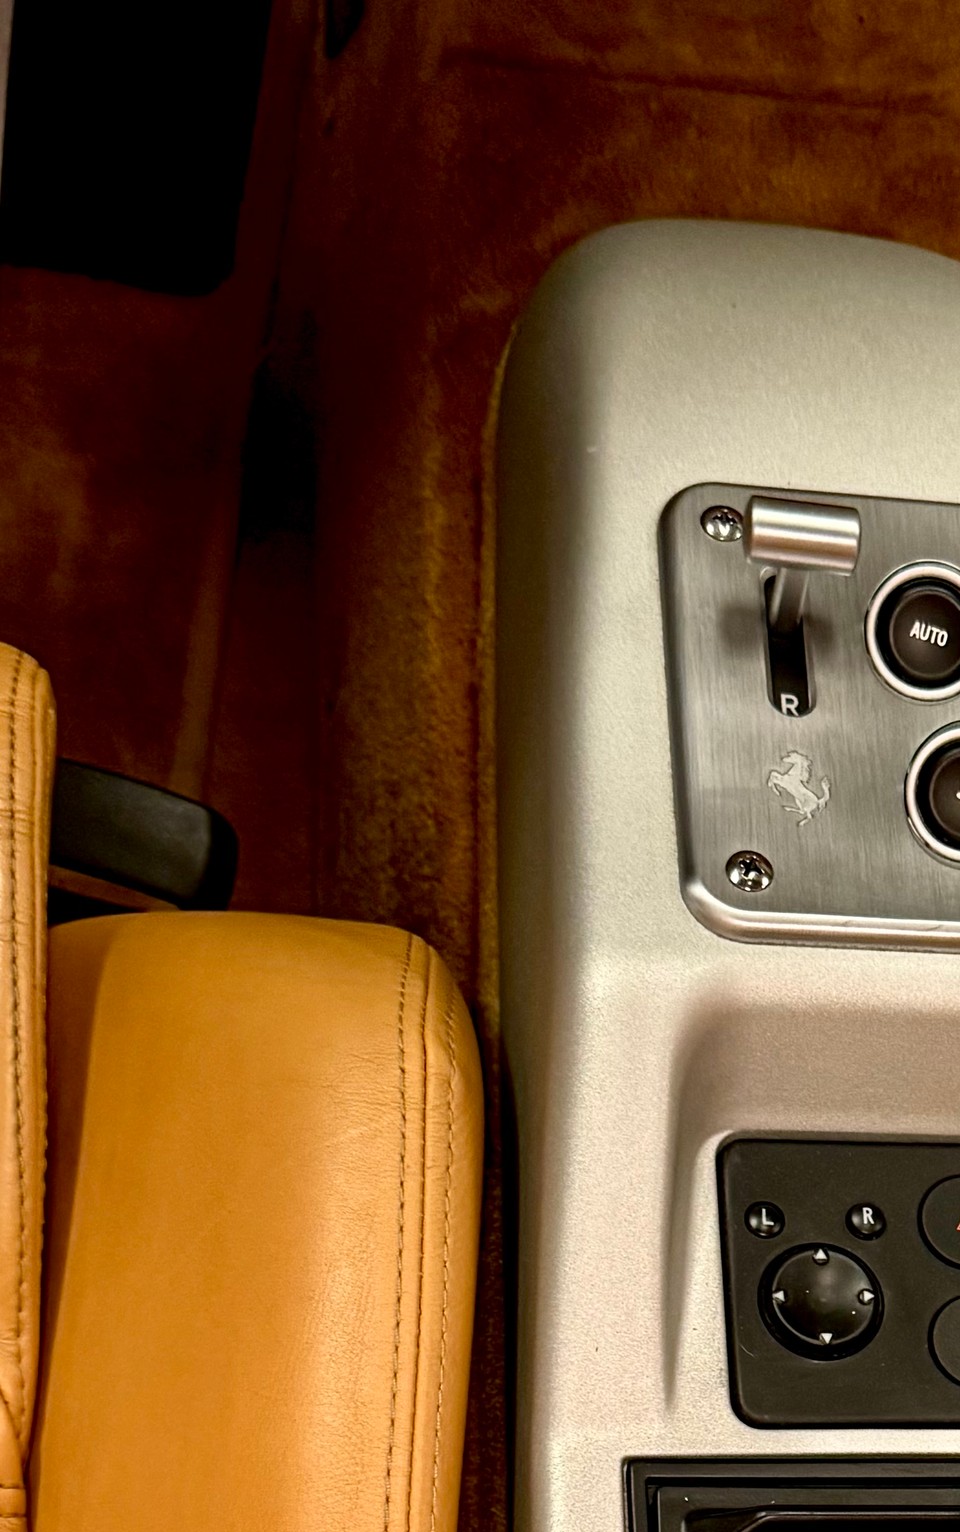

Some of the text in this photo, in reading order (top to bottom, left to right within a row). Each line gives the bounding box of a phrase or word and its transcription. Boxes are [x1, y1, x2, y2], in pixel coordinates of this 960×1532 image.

[909, 621, 948, 647] AUTO
[780, 694, 799, 716] R
[761, 1208, 775, 1226] L
[862, 1207, 875, 1226] R
